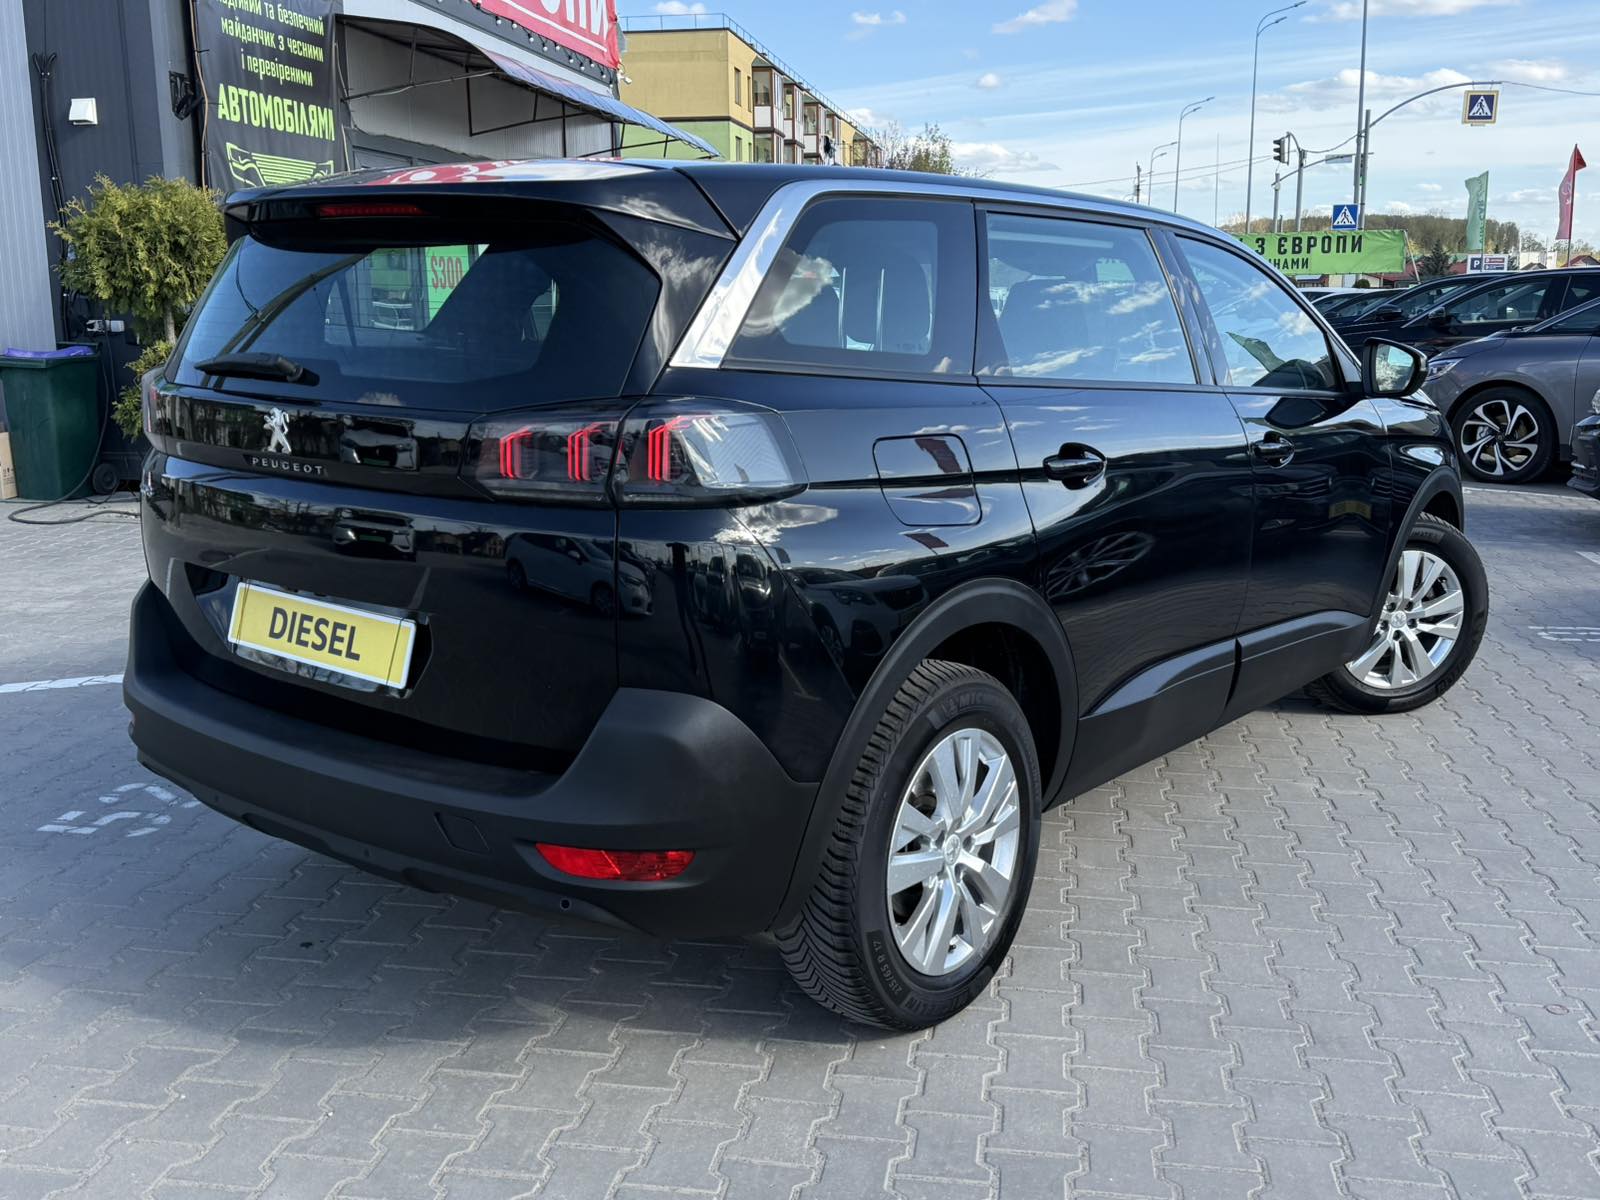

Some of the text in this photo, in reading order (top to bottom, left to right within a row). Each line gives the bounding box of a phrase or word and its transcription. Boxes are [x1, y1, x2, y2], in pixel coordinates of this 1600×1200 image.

[264, 2, 275, 20] та
[277, 4, 325, 36] безпечний
[220, 16, 276, 49] майданчик
[287, 37, 324, 62] чесними
[240, 48, 314, 87] і перевіреними
[217, 83, 336, 142] АВТОМОБІЛЯМИ
[1255, 234, 1364, 255] З ЄВРОПИ
[1268, 257, 1310, 270] НАМИ
[251, 456, 324, 476] PEUGEOT
[268, 606, 361, 662] DIESEL
